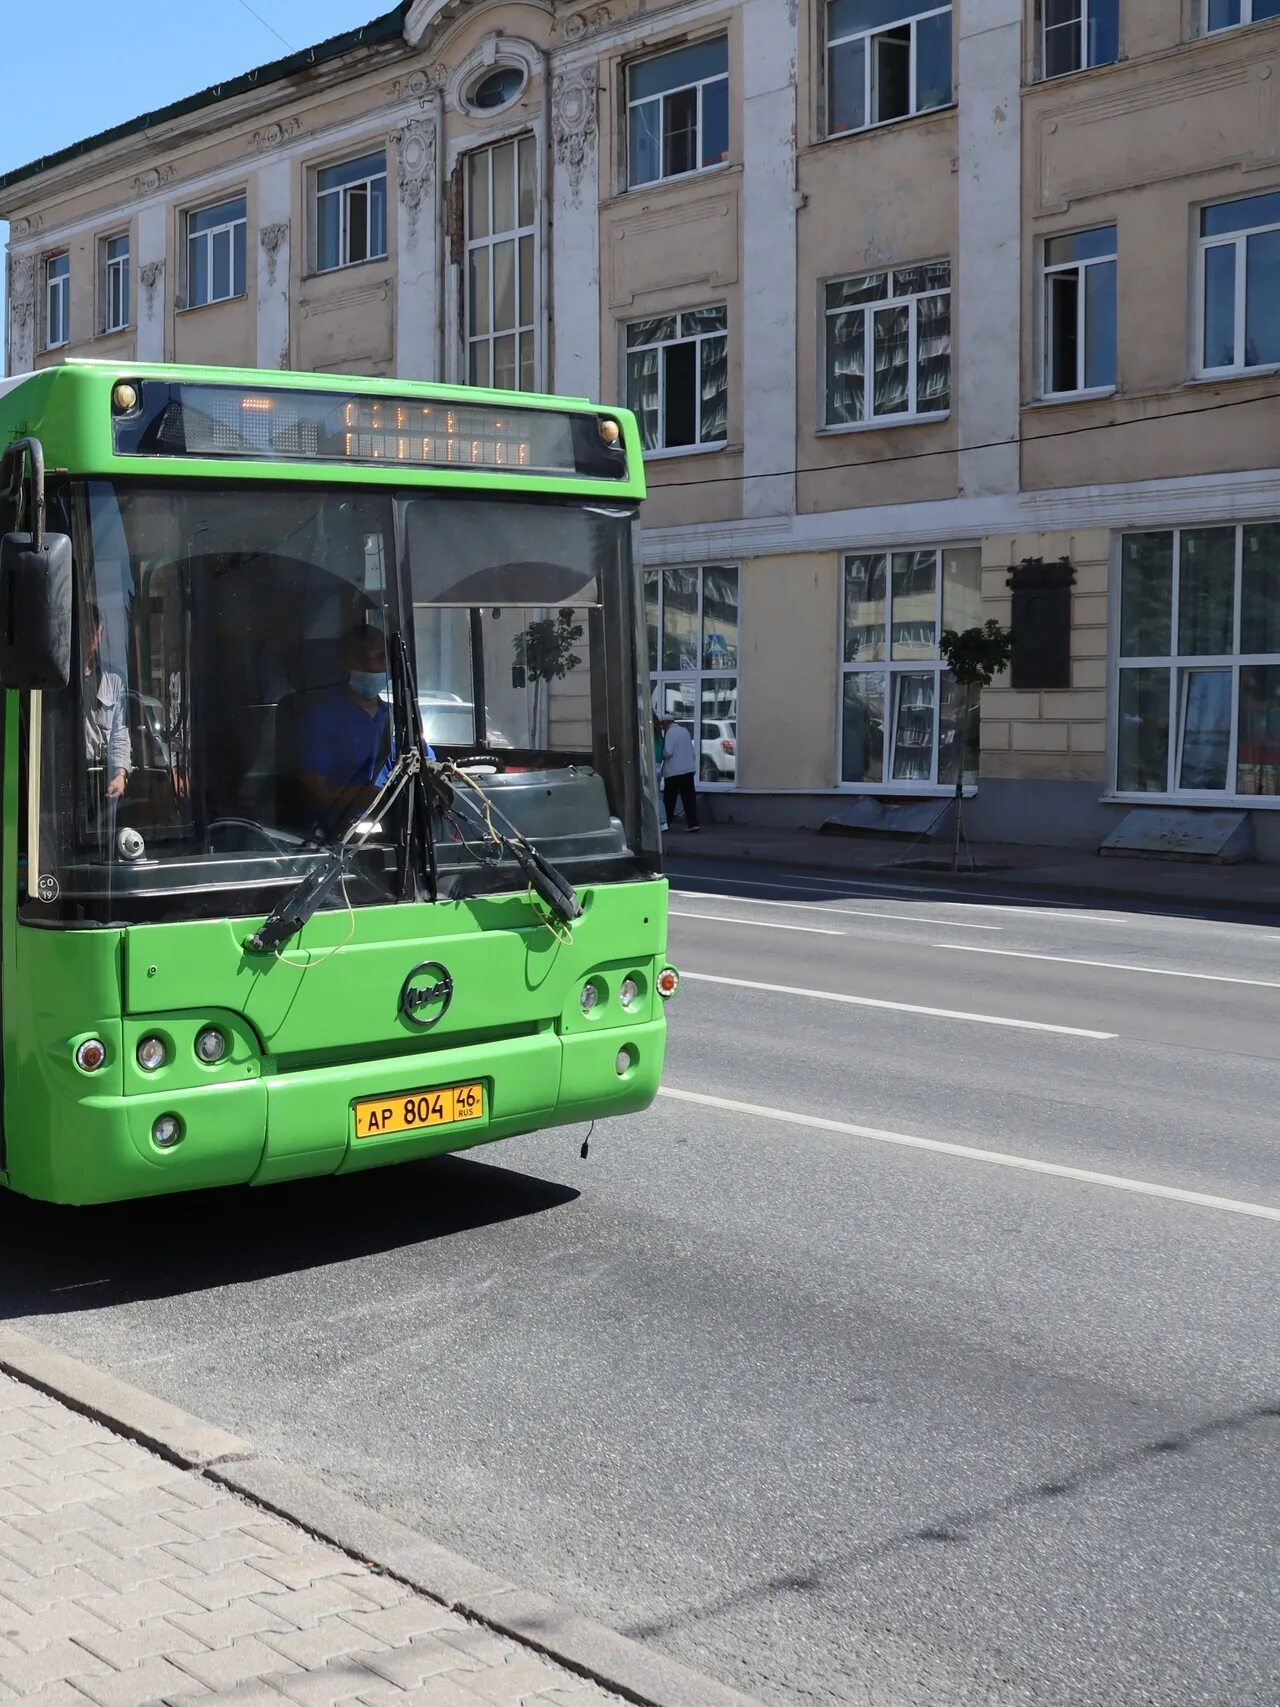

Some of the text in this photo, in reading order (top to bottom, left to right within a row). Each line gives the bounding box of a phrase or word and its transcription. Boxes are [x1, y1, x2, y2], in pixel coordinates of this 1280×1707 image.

[42, 890, 52, 899] 19
[368, 1087, 476, 1131] АР 804 46
[458, 1108, 474, 1118] RUS
